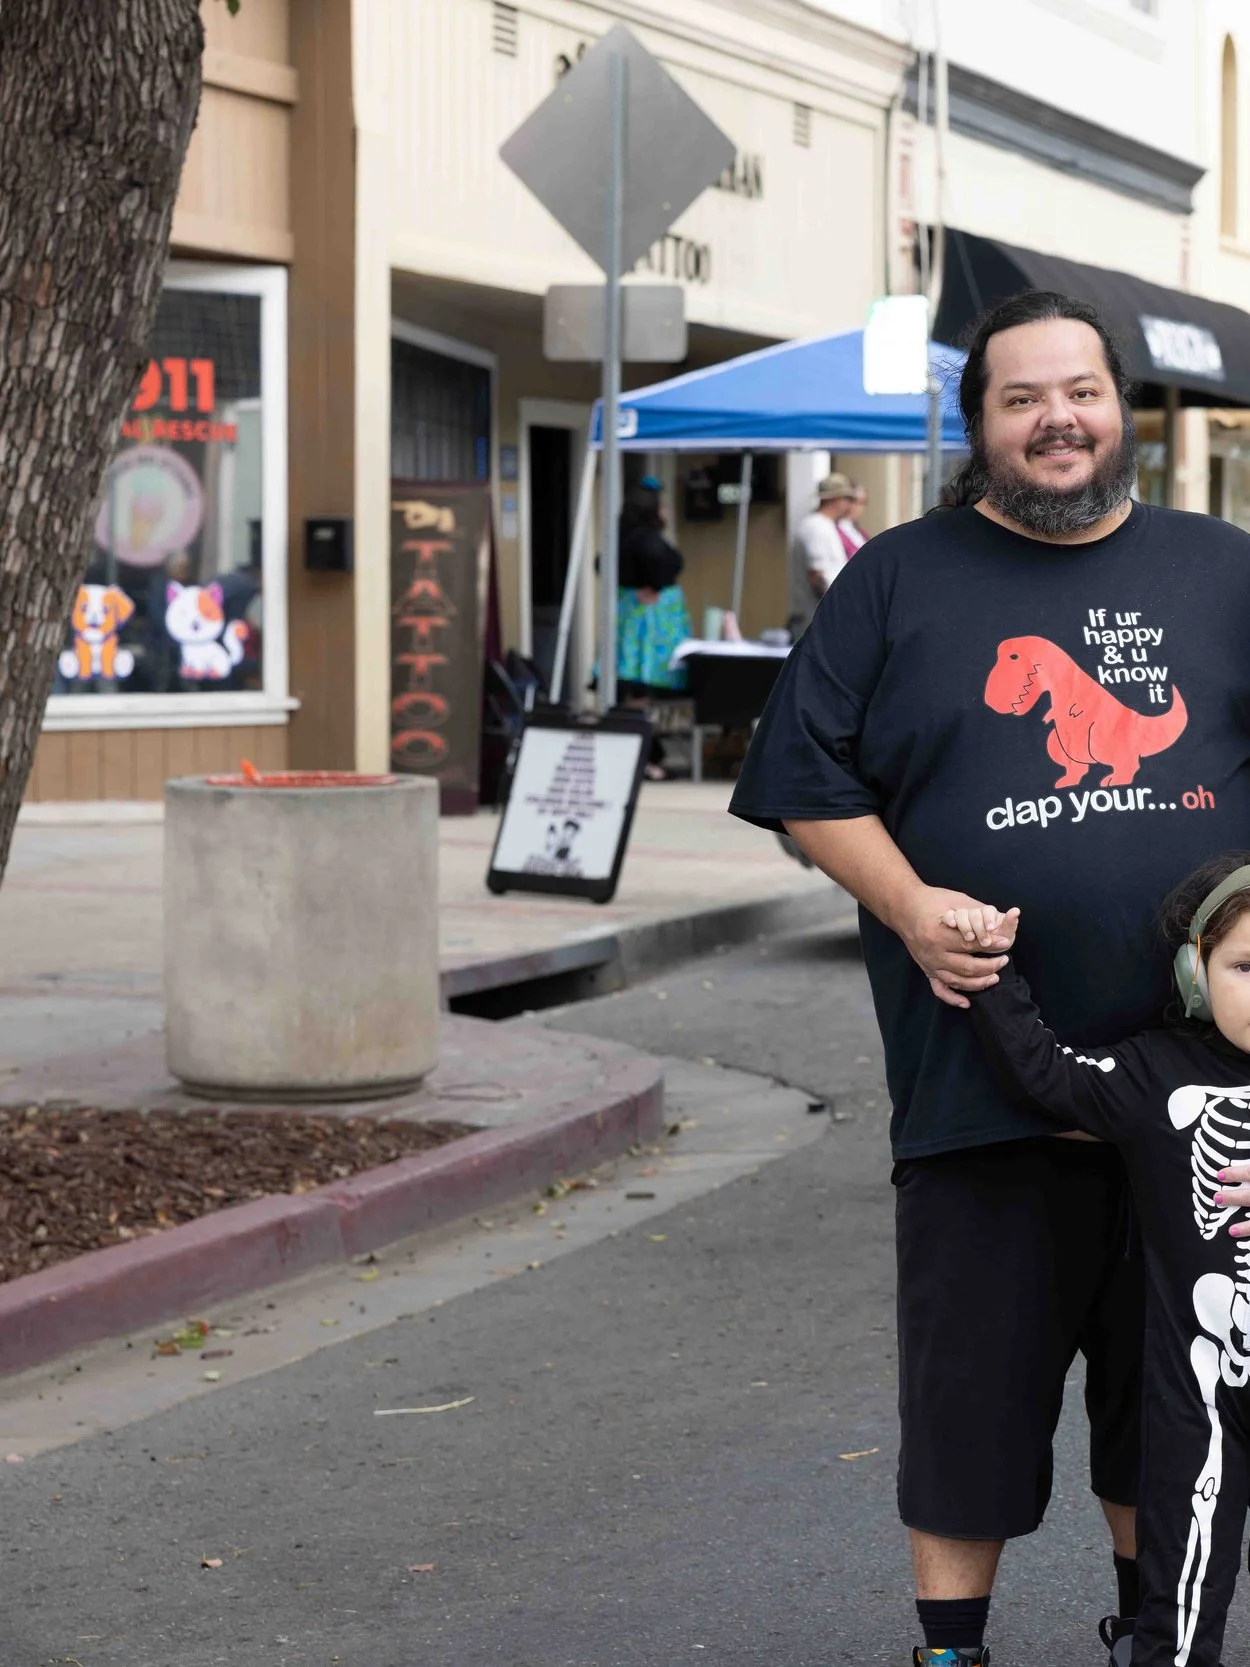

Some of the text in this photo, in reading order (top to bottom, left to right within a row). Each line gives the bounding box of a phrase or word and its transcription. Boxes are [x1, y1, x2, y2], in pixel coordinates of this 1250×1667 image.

[1088, 608, 1142, 628] If ur
[1083, 625, 1163, 648] happy
[391, 540, 457, 766] TATTOO
[1103, 645, 1148, 665] & u
[1097, 665, 1169, 685] know
[1148, 683, 1167, 704] it
[985, 784, 1216, 831] clap your... oh
